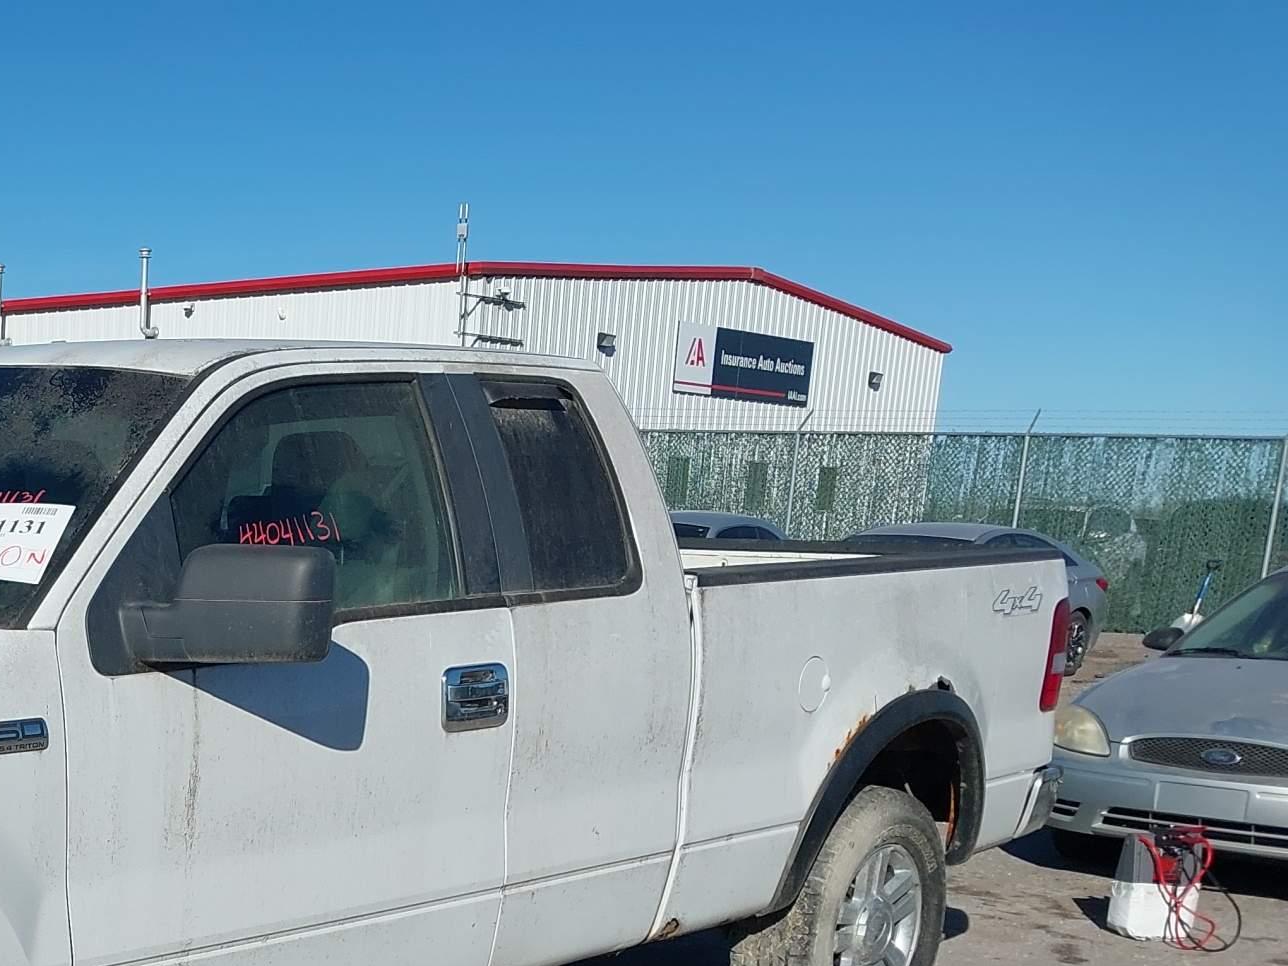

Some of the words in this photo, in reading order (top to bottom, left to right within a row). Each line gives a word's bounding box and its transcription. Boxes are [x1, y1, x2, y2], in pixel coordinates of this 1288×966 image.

[721, 350, 757, 370] Insurance
[757, 355, 774, 372] Auto
[775, 357, 805, 376] Auctions
[239, 511, 341, 546] 44041131
[992, 586, 1043, 615] 4x4
[14, 741, 45, 751] TRITON
